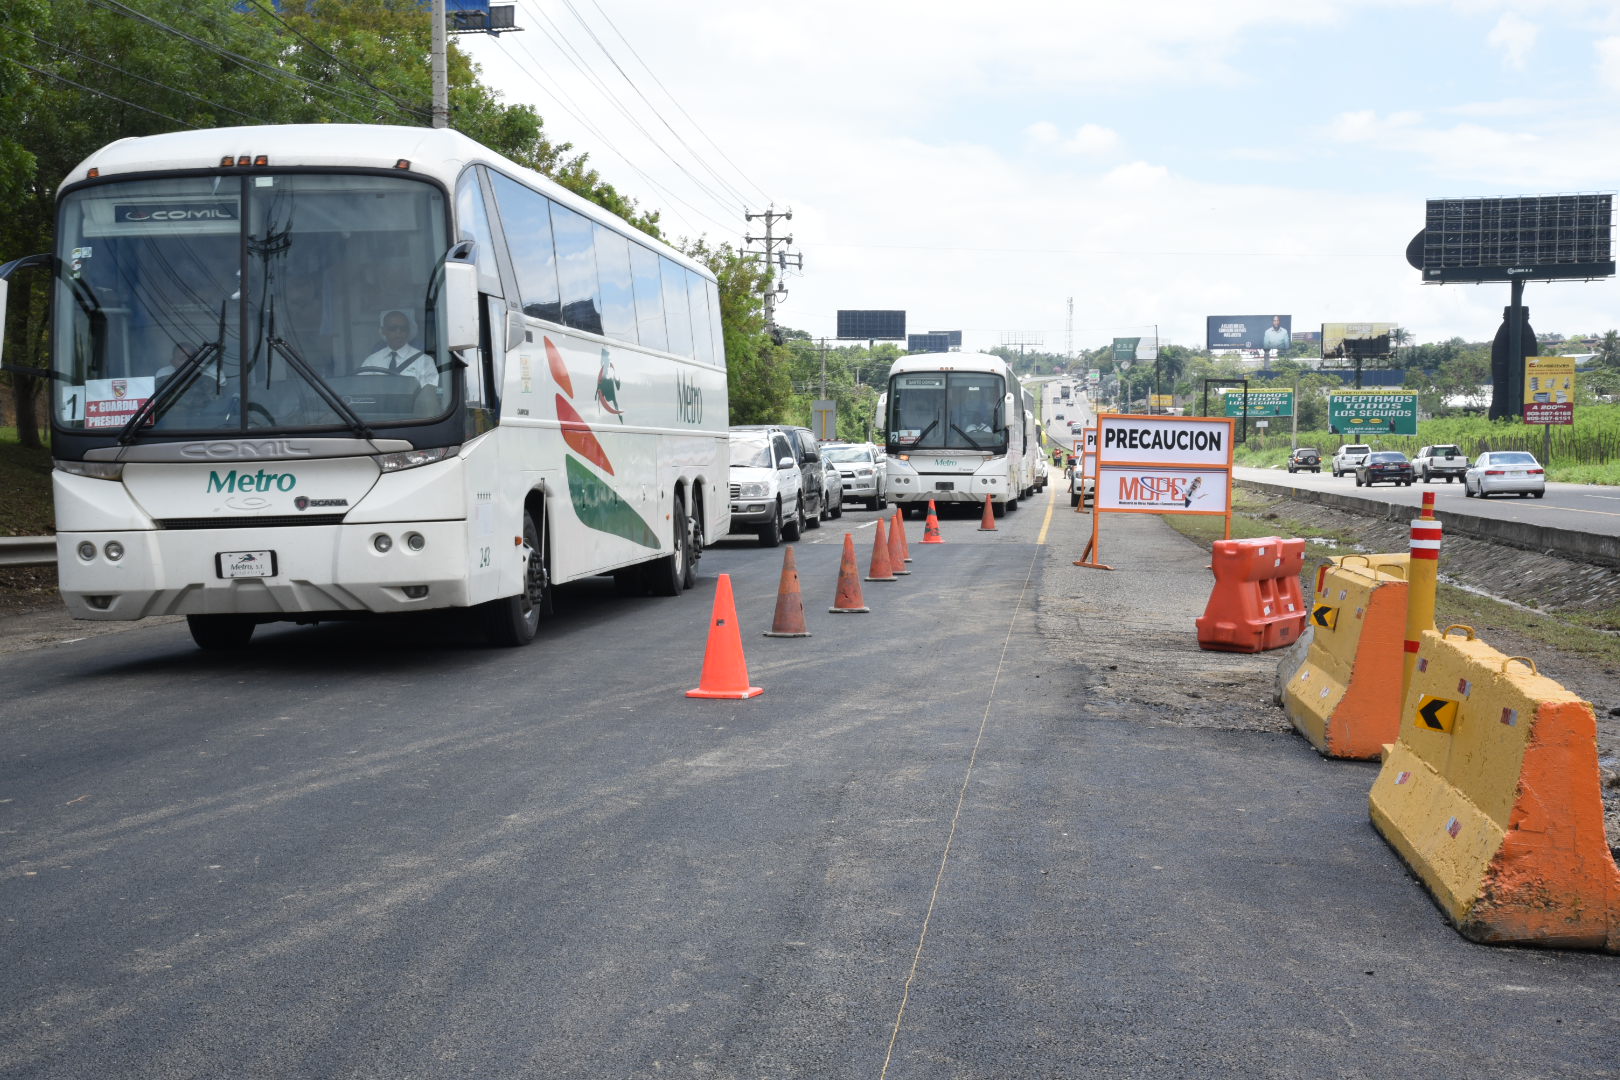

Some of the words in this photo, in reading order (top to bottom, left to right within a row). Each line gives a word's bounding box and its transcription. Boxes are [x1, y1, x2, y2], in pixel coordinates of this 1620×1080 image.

[152, 210, 231, 220] COMIL
[676, 368, 703, 424] Metro
[1333, 395, 1413, 403] ACEPTAMOS
[98, 400, 138, 413] GUARDIA
[1105, 428, 1221, 451] PRECAUCION
[180, 441, 311, 458] COMIL
[934, 459, 957, 467] Metro
[206, 469, 297, 494] Metro
[310, 499, 349, 507] SCANIA
